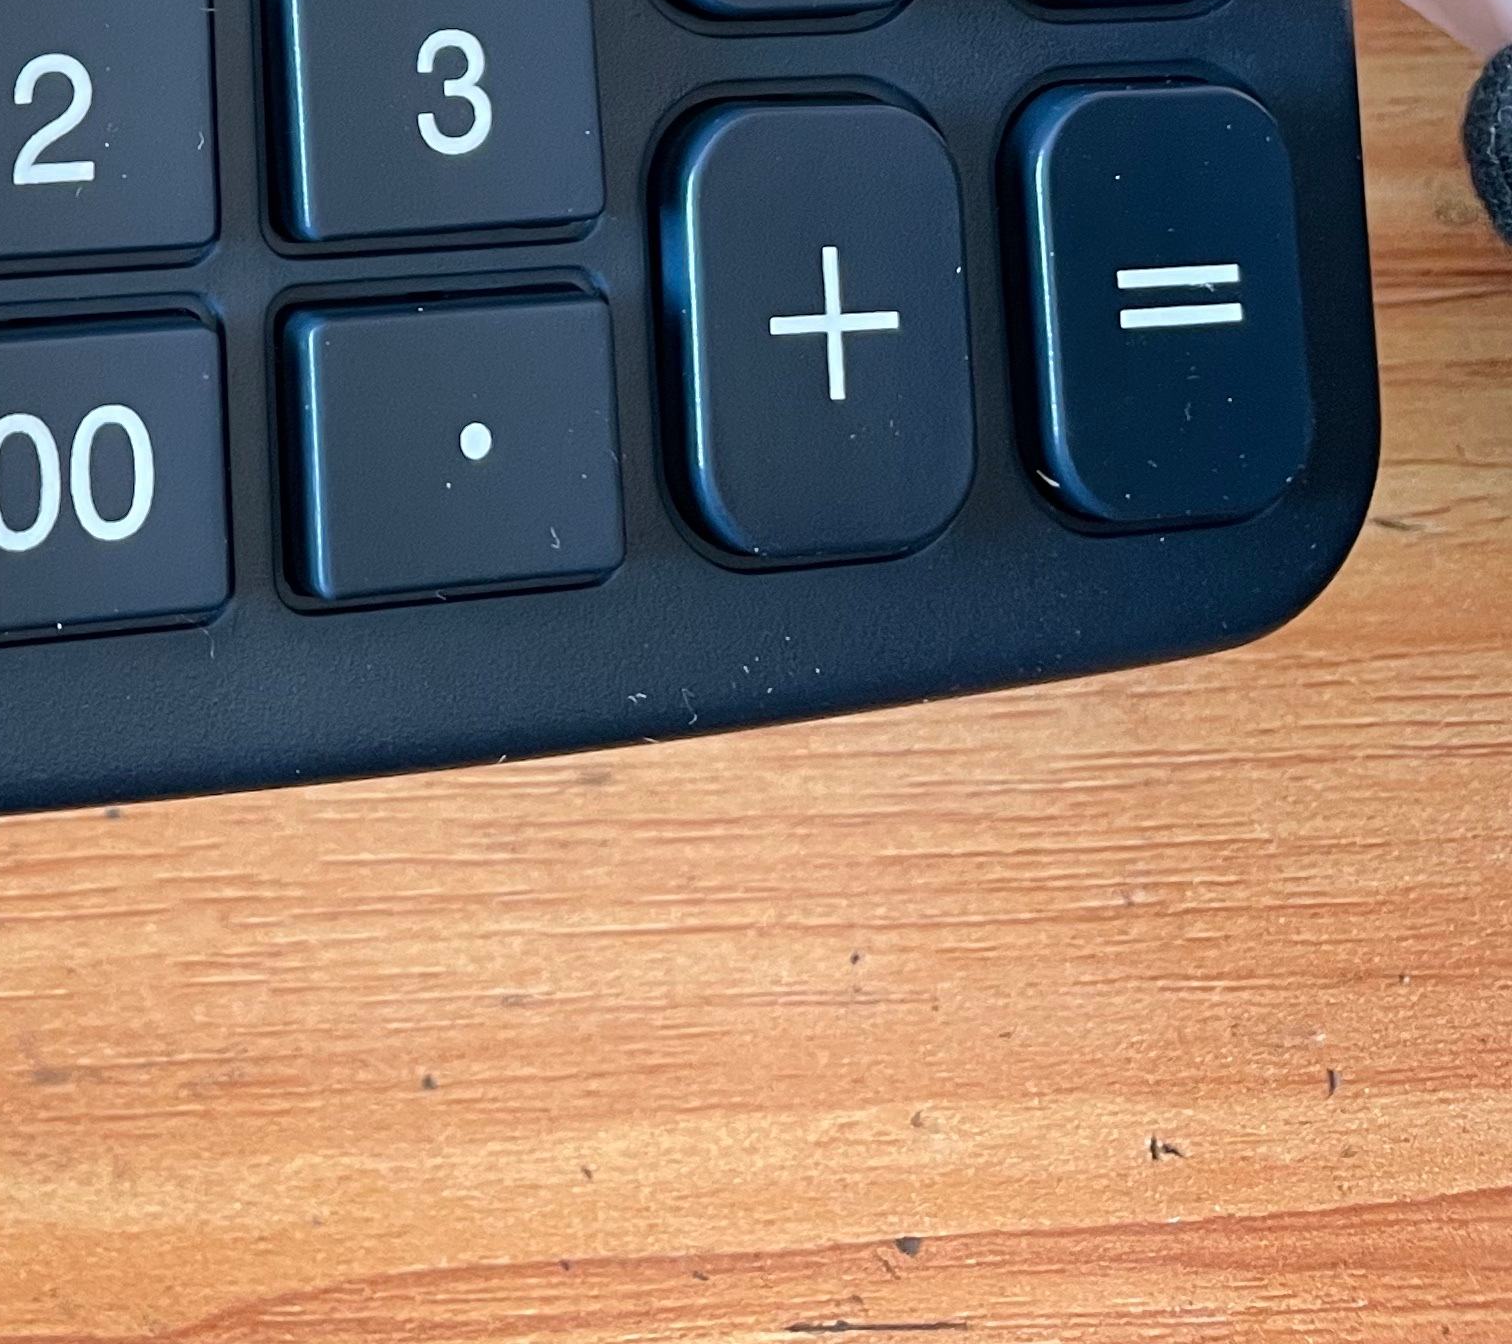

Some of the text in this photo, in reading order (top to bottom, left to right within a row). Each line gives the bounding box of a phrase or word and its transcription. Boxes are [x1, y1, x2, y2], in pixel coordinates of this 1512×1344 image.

[12, 53, 96, 186] 2
[416, 28, 493, 156] 3
[768, 245, 900, 401] +
[1115, 262, 1244, 330] =
